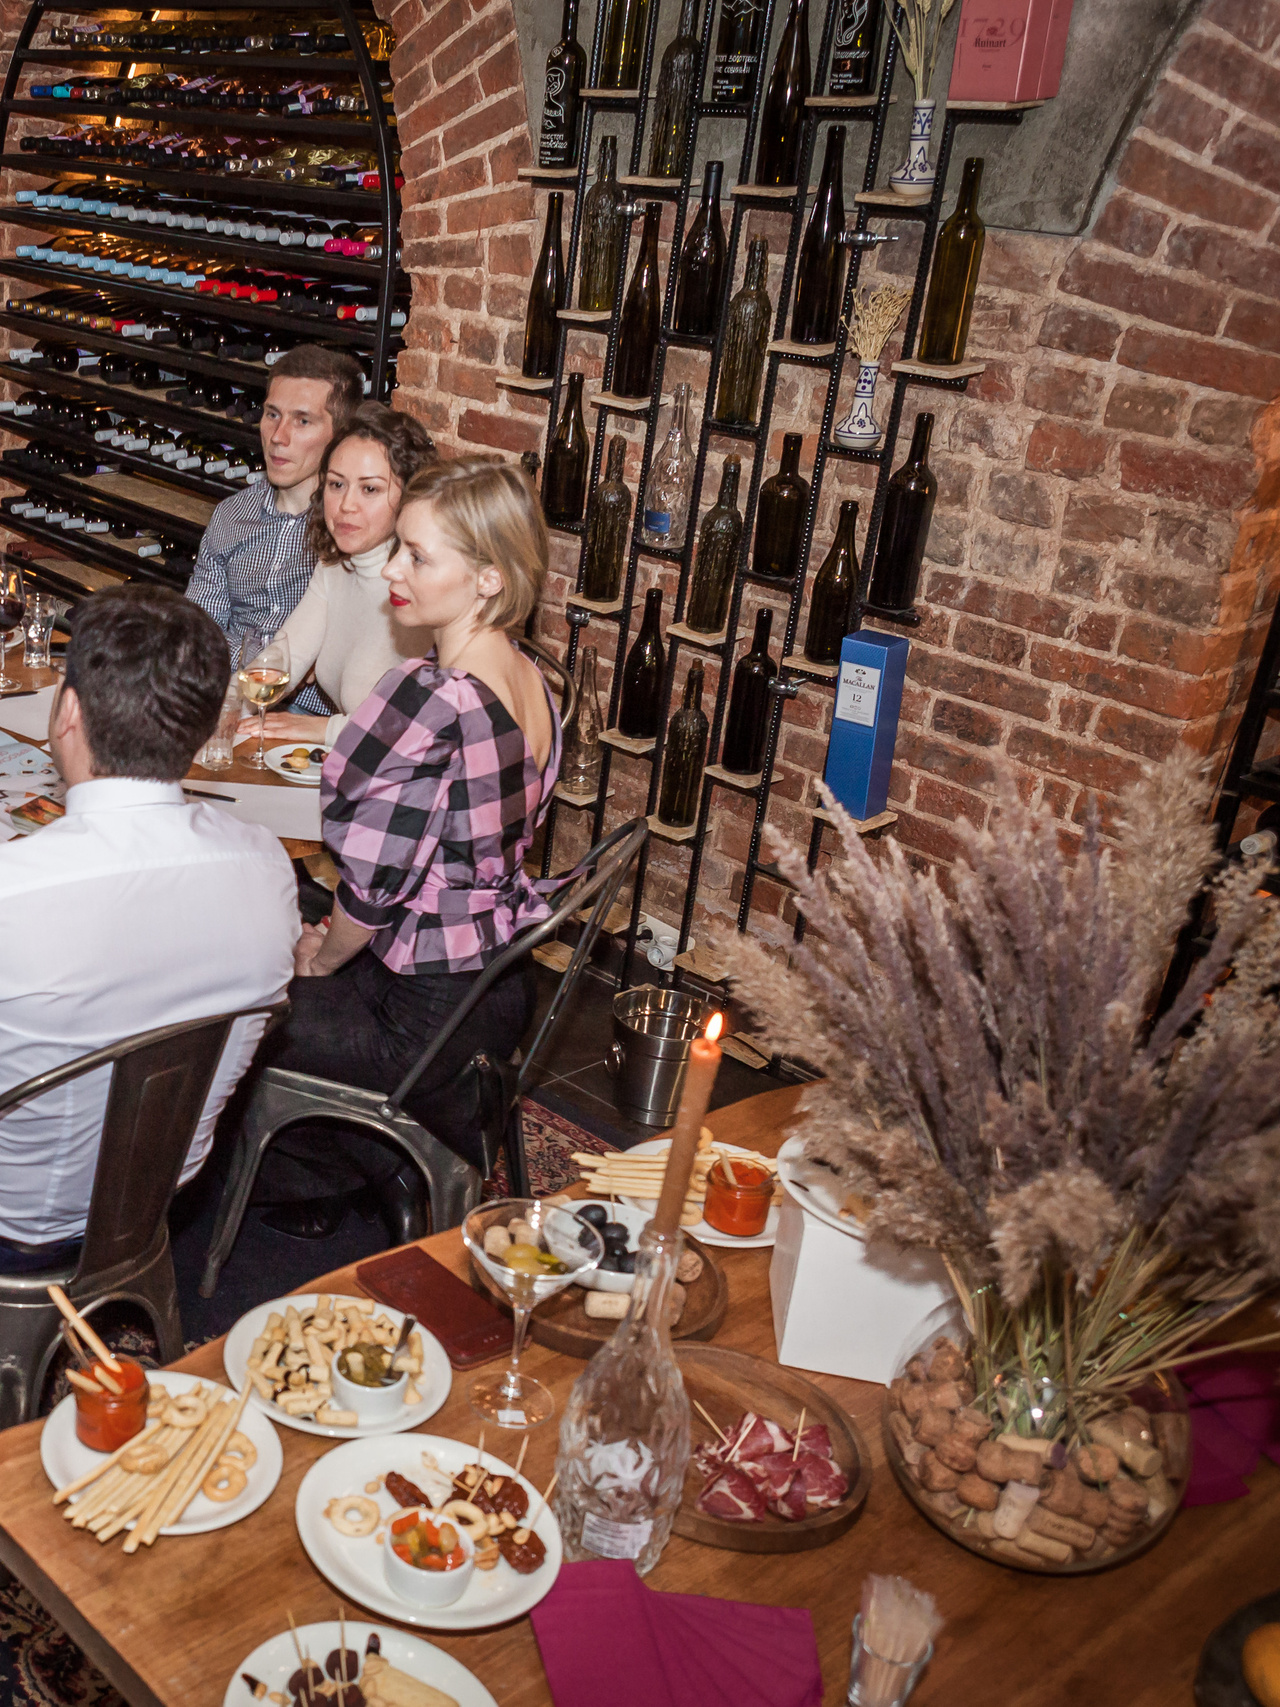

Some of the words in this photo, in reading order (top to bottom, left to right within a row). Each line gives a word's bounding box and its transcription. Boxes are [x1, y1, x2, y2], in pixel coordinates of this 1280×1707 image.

[959, 17, 1026, 46] 1729
[842, 678, 876, 691] MACALLAN
[852, 693, 862, 703] 12
